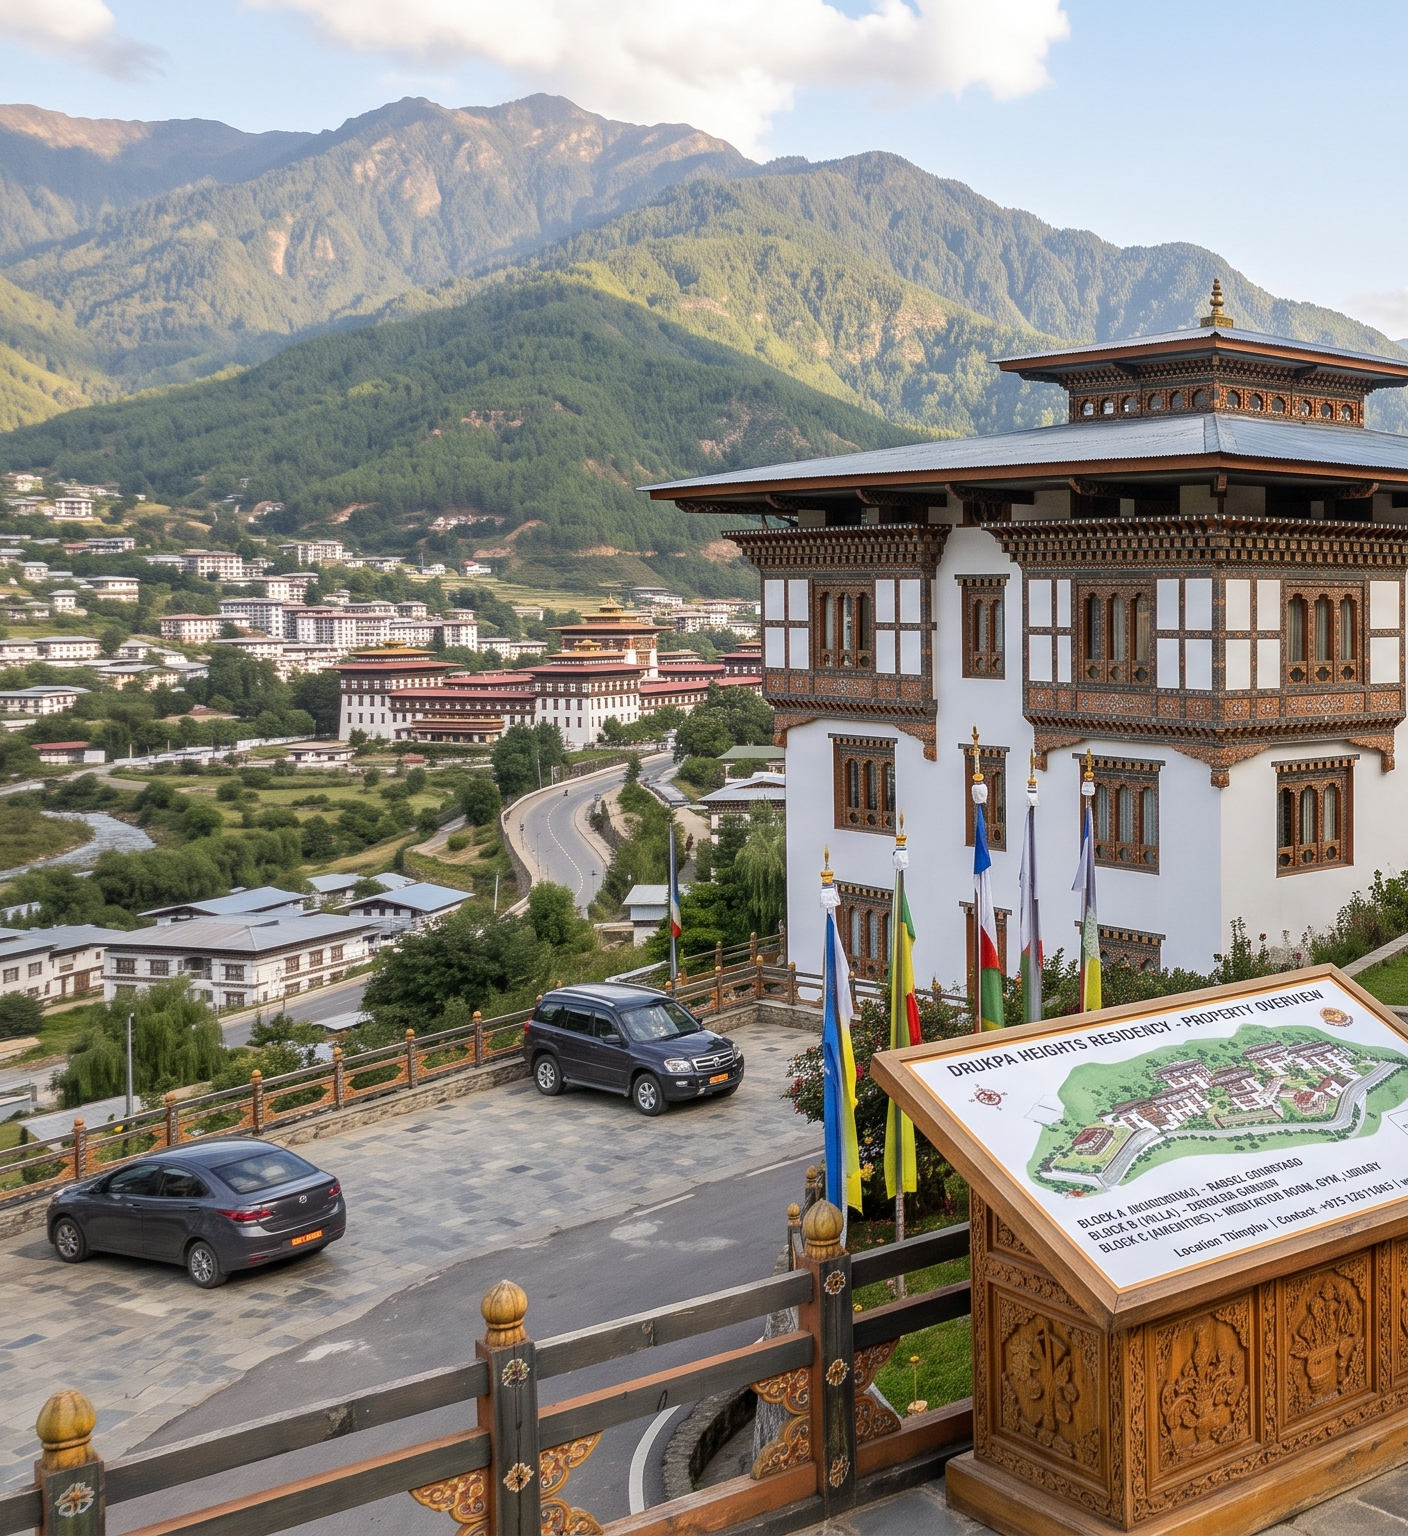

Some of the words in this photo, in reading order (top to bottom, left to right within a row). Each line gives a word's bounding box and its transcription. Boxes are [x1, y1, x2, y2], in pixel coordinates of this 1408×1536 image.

[946, 1053, 1019, 1077] DRUKPA
[1016, 1038, 1088, 1062] HEIGHTS
[1086, 1020, 1172, 1047] RESIDENCY
[1180, 1004, 1254, 1028] PROPERTY
[1254, 989, 1324, 1012] OVERVIEW
